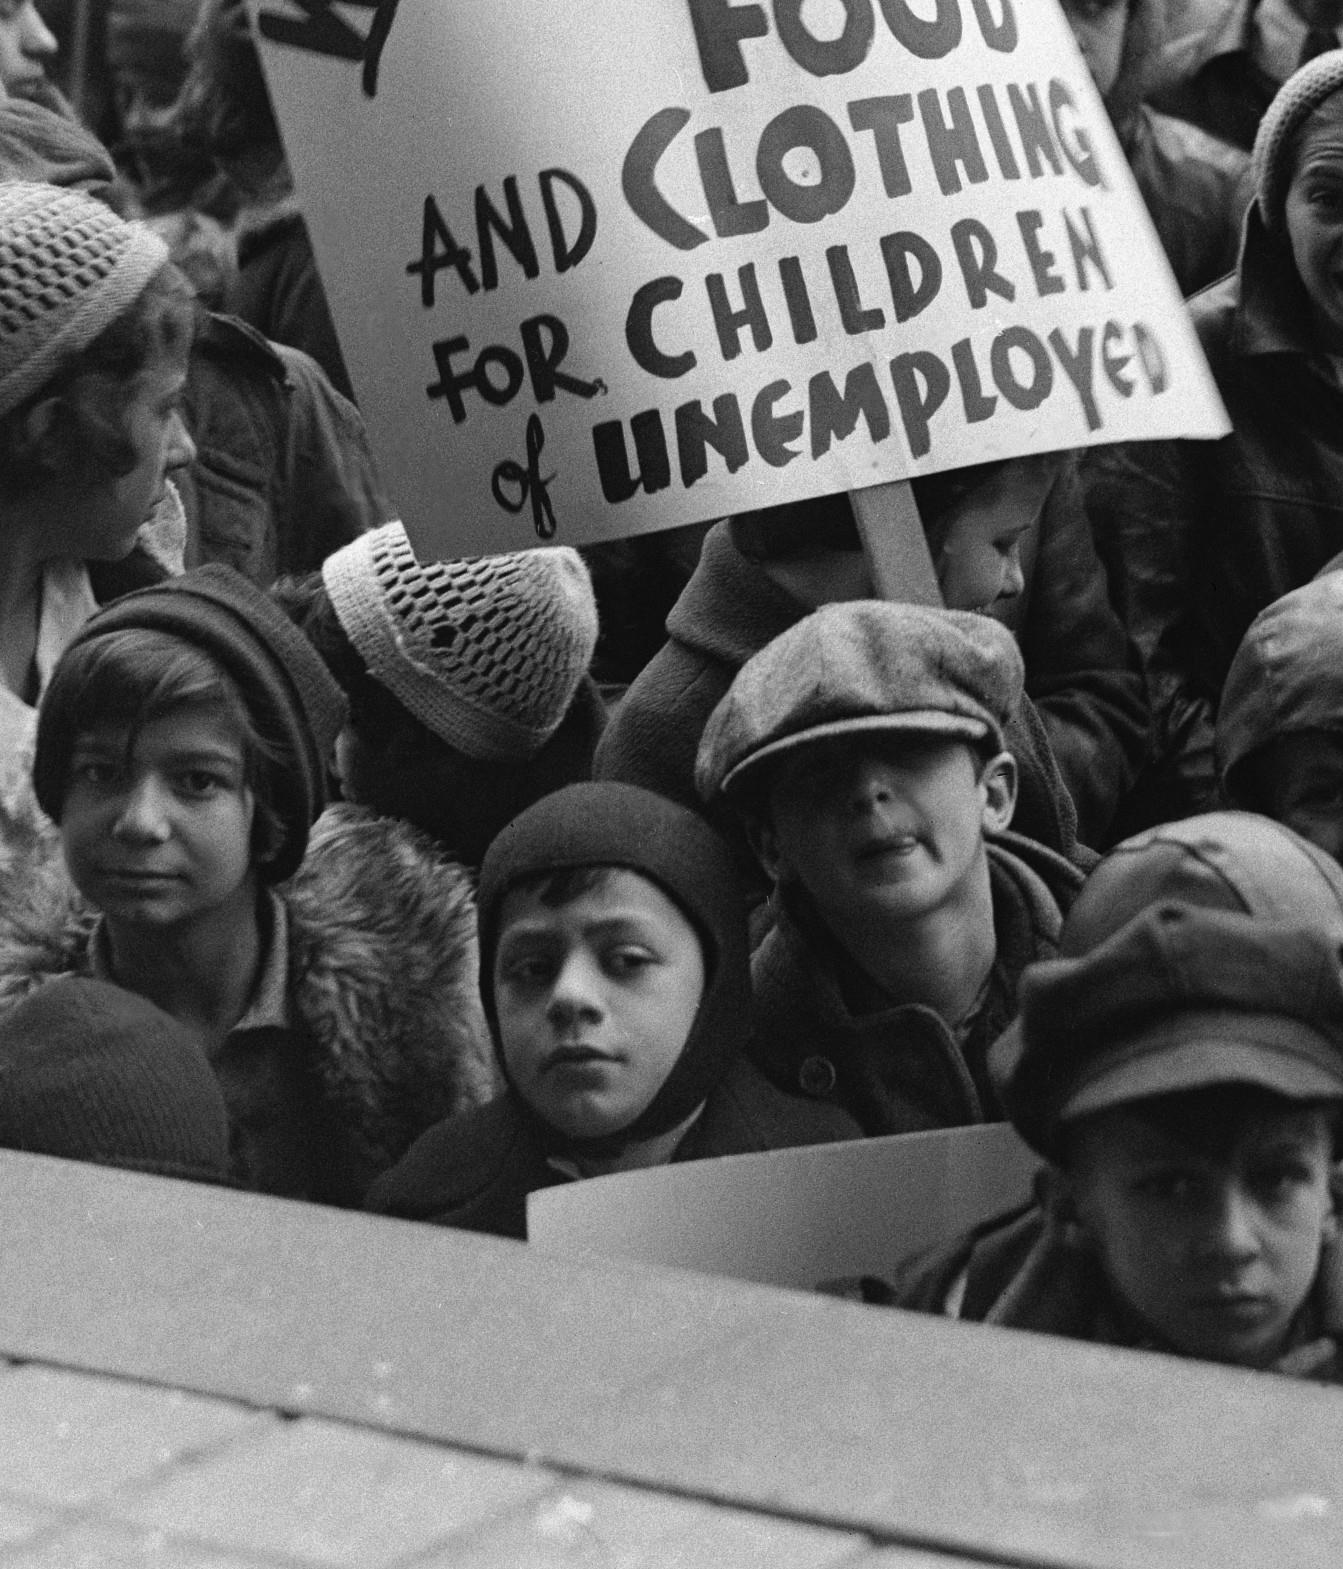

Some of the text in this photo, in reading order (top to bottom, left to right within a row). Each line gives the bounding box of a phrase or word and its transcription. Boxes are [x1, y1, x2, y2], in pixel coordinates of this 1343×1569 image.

[406, 75, 1110, 309] AND CLOTHING
[426, 206, 1115, 424] FOR CHILDREN
[491, 321, 1168, 539] of UNEMPLOYED
